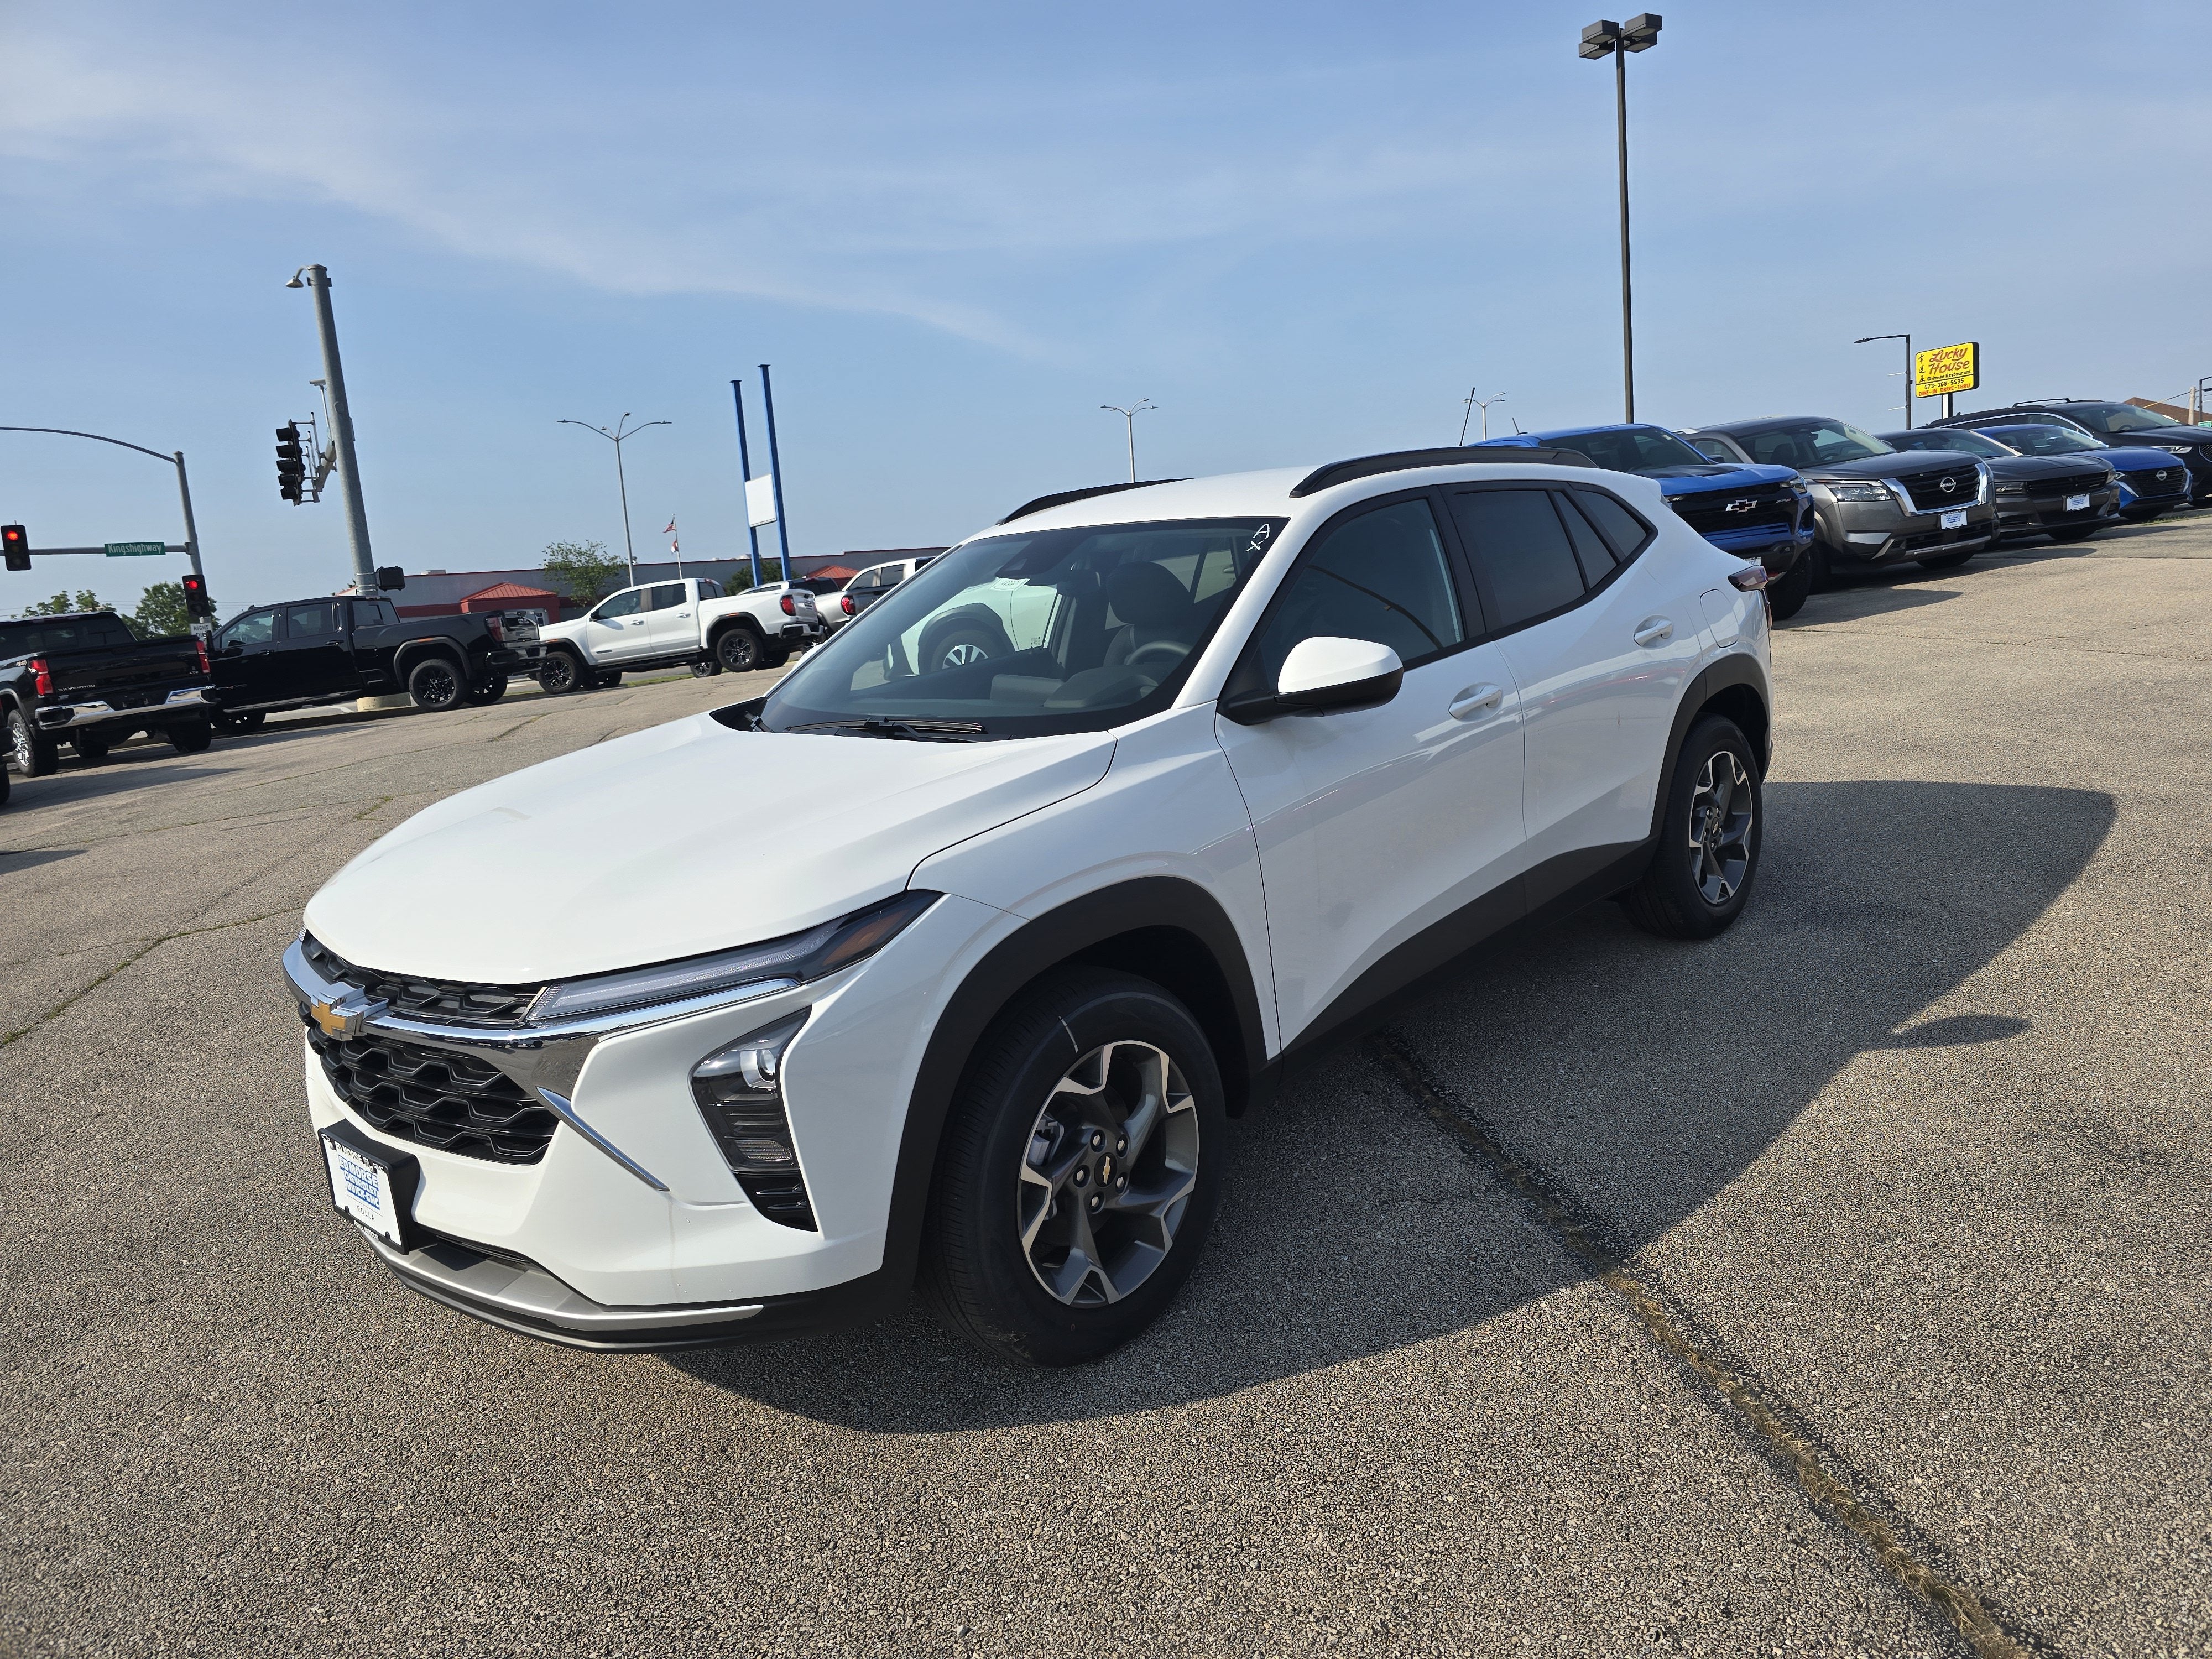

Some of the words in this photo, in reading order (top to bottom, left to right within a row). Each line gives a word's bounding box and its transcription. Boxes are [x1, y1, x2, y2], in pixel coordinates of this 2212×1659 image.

[1929, 347, 1968, 363] Lucky
[1928, 360, 1970, 375] House
[1945, 369, 1971, 378] Restaurant
[1253, 524, 1270, 539] A
[108, 544, 161, 555] Kingshighway
[335, 1140, 342, 1151] ED
[342, 1145, 362, 1162] MORSE
[339, 1155, 349, 1171] ED
[348, 1161, 378, 1188] MORSE
[344, 1170, 378, 1197] CHEVROLET
[357, 1205, 375, 1222] ROLLA
